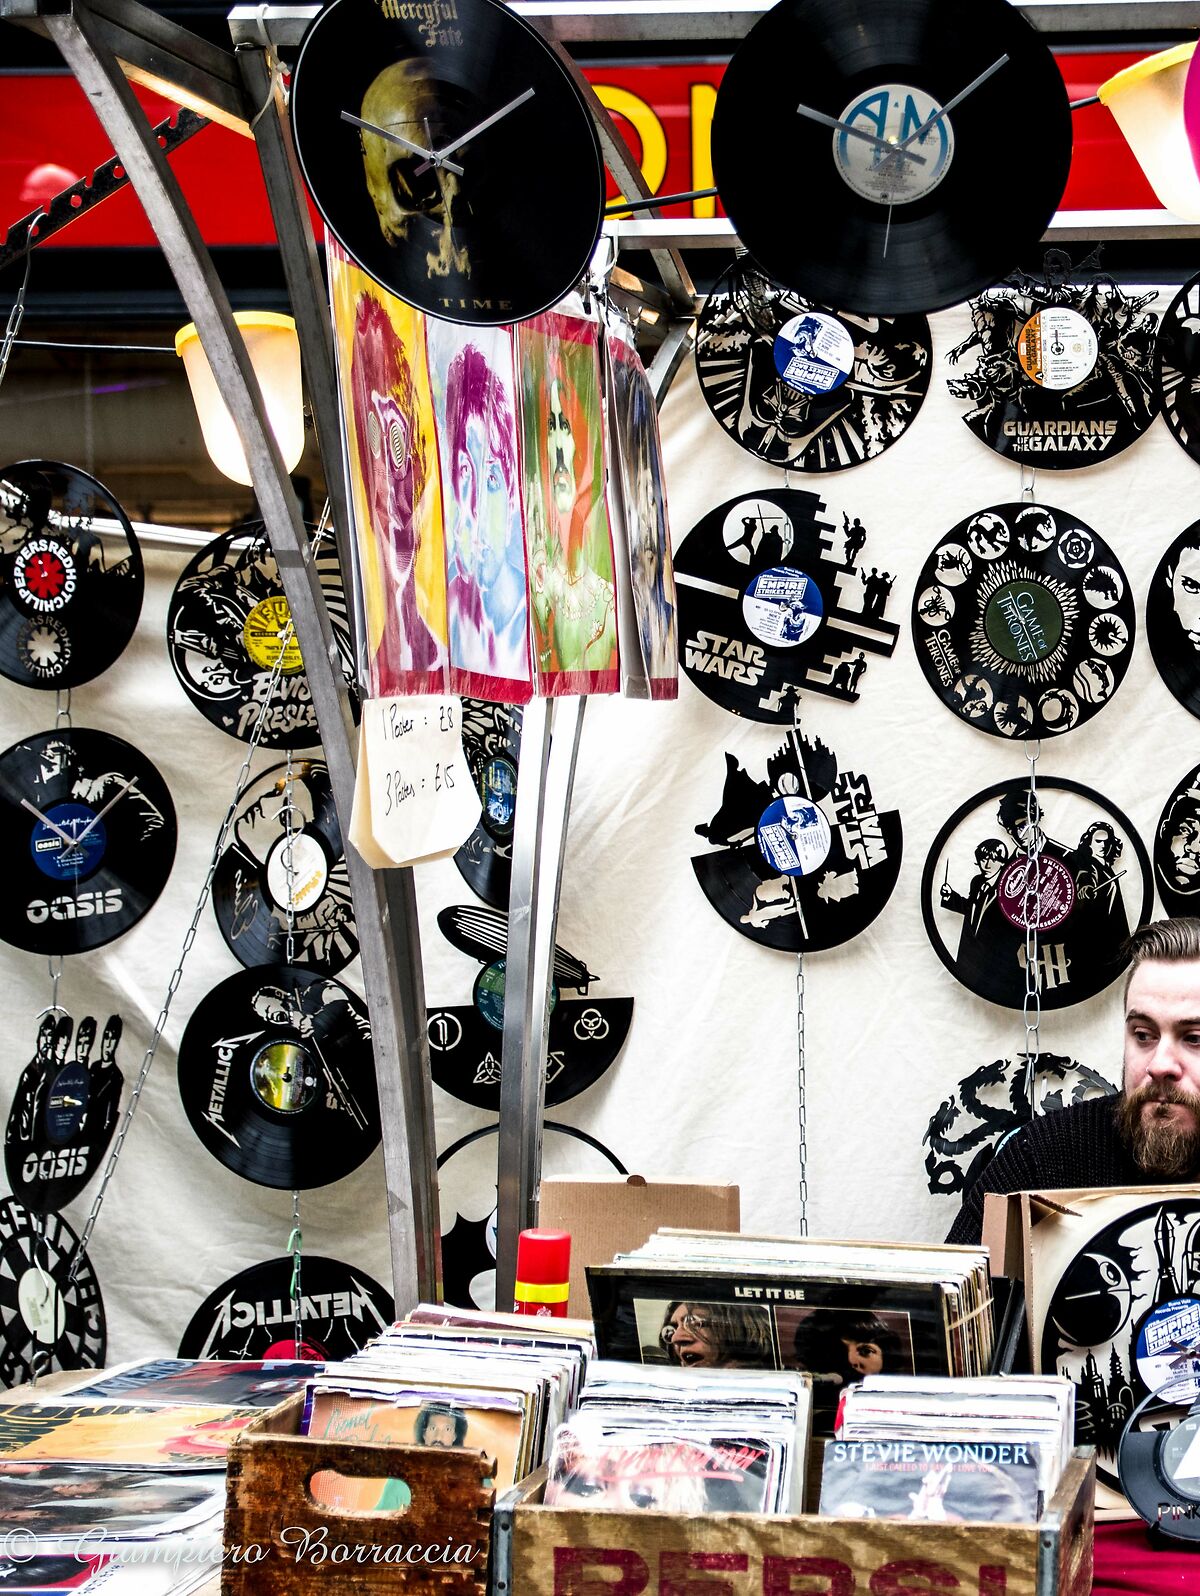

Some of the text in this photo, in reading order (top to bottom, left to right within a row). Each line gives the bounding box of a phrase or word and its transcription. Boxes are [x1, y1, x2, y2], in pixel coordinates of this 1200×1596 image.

[418, 24, 464, 47] Fate
[438, 298, 513, 311] TIME
[1003, 420, 1118, 437] GUARDIANS
[1012, 444, 1029, 452] THE
[1028, 436, 1112, 452] GALAXY
[758, 580, 806, 591] EMPIRE
[261, 602, 292, 621] SU
[997, 590, 1037, 662] THRONES
[1016, 592, 1046, 642] GAME
[685, 630, 768, 668] STAR
[924, 631, 953, 687] THRONES
[938, 629, 957, 667] GAME
[685, 646, 765, 687] WARS
[252, 671, 312, 702] ELVIS
[237, 701, 322, 737] PRESLE
[389, 703, 415, 741] Poster
[831, 771, 869, 871] STAR
[849, 771, 888, 868] WARS
[36, 839, 60, 850] oasis
[201, 1030, 266, 1149] METALLICA
[734, 1286, 805, 1301] LET IT BE
[1148, 1311, 1200, 1341] EMPIRE
[1149, 1330, 1180, 1350] STRIKES
[833, 1443, 1030, 1465] STEVIE WONDER
